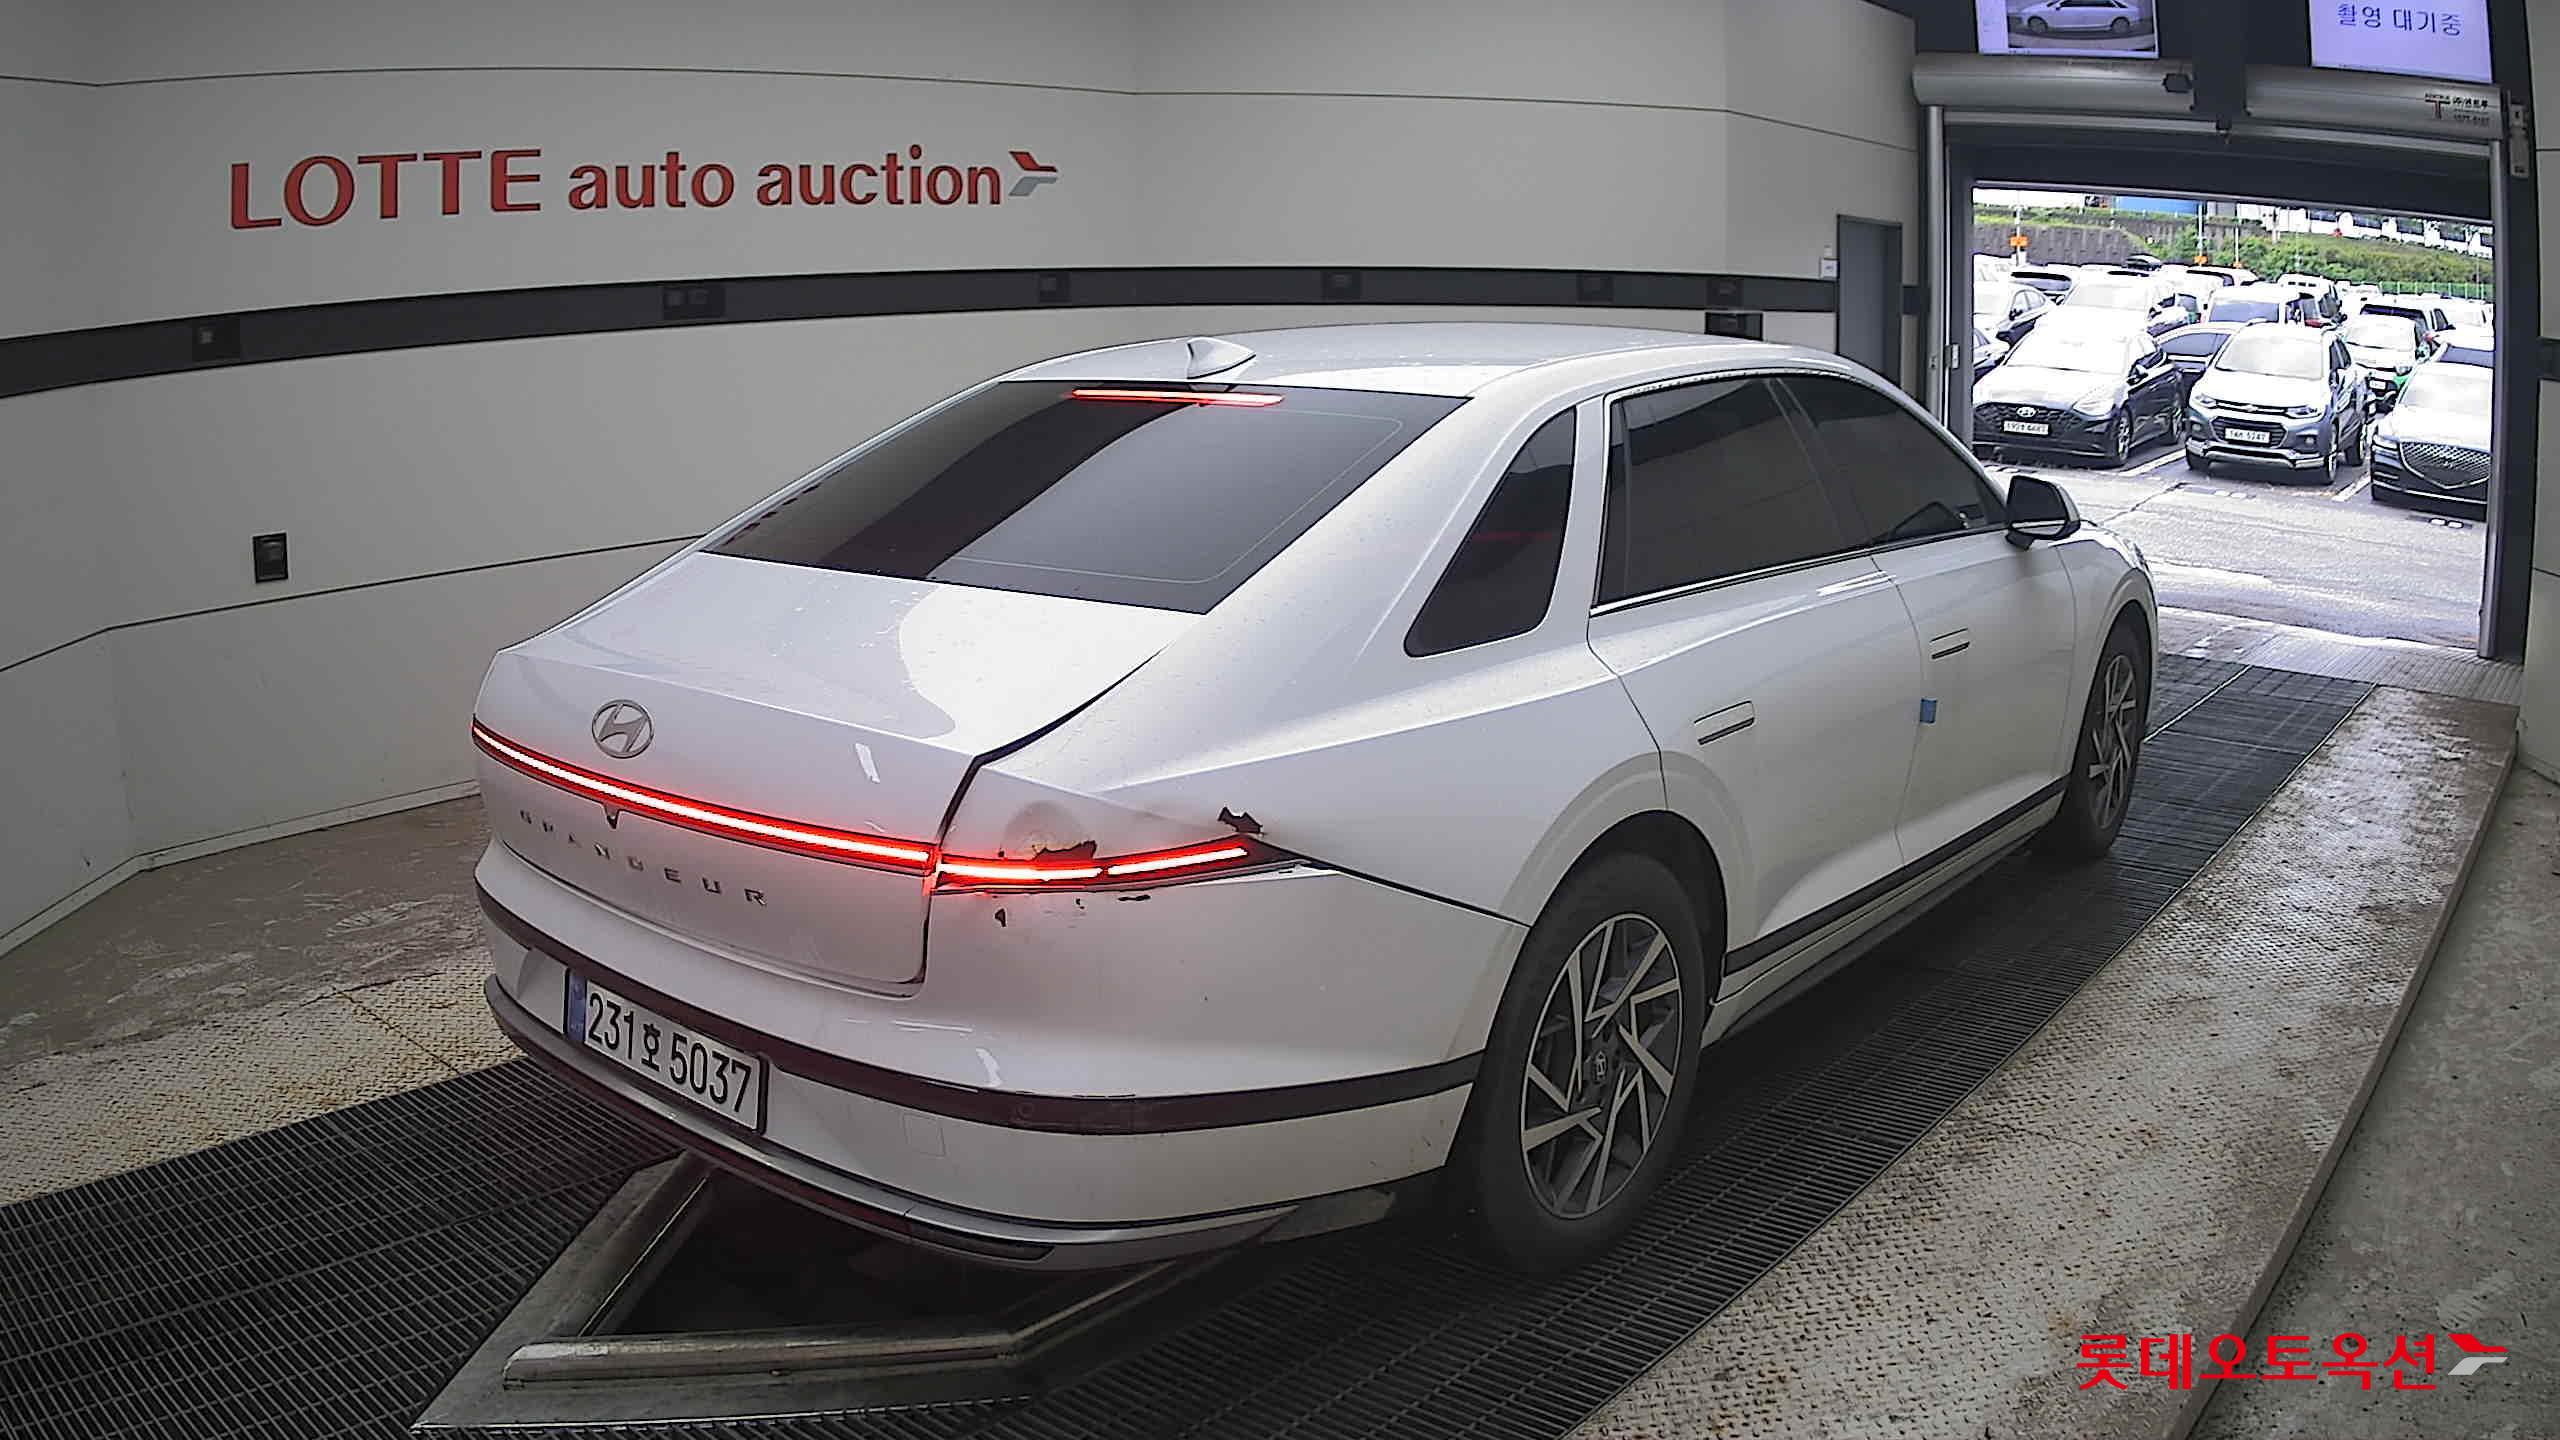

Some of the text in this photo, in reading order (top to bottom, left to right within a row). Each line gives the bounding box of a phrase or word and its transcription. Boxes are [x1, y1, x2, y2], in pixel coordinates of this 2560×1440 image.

[2338, 4, 2461, 36] 촬영 대기중
[229, 144, 1002, 229] LOTTE auto auction
[588, 993, 752, 1113] 231호 5037
